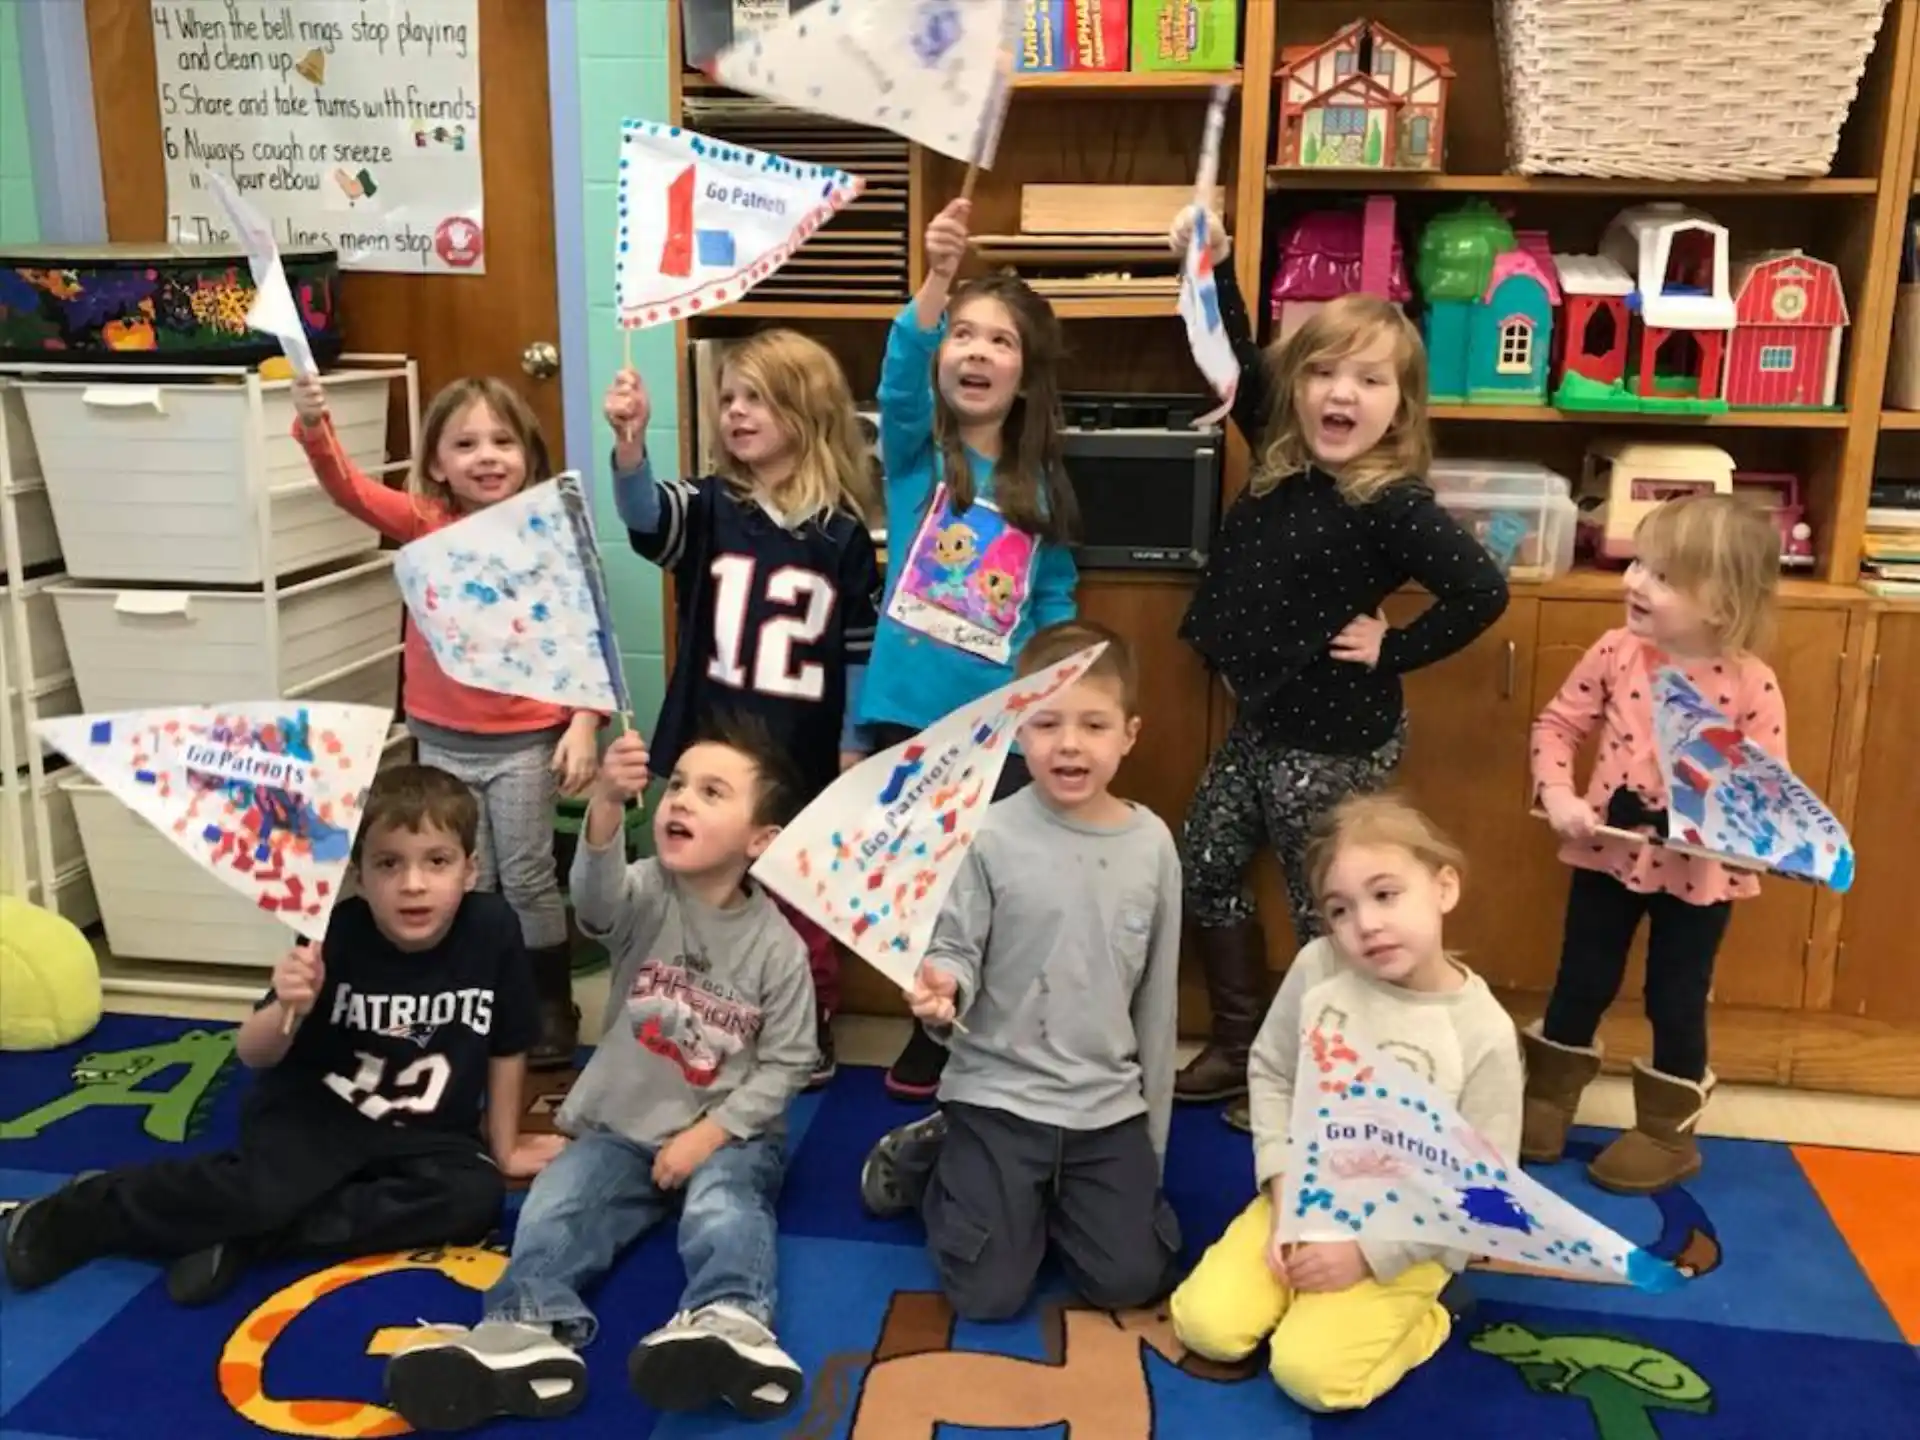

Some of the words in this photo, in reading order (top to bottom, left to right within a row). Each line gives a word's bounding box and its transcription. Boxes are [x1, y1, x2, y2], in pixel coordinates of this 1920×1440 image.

[175, 7, 227, 41] When
[229, 7, 259, 41] the
[261, 7, 294, 41] bell
[299, 20, 343, 54] rings
[352, 10, 389, 55] stop
[397, 9, 468, 59] playing
[178, 41, 210, 71] and
[214, 43, 263, 71] clean
[268, 52, 293, 84] up
[179, 81, 234, 116] Share
[238, 88, 269, 117] and
[274, 84, 310, 117] take
[315, 87, 361, 118] turns
[363, 87, 405, 119] with
[406, 83, 476, 119] friends
[184, 127, 245, 172] Always
[252, 130, 304, 170] cough
[309, 144, 327, 162] or
[333, 143, 393, 164] sneeze
[232, 172, 265, 196] your
[269, 164, 320, 190] elbow
[705, 180, 728, 203] Go
[731, 186, 786, 216] Patriots
[191, 215, 230, 245] The
[286, 216, 333, 247] lines
[340, 231, 390, 252] mean
[394, 222, 433, 267] stop
[706, 551, 837, 702] 12
[186, 744, 215, 766] Go
[218, 750, 305, 785] Patriots
[861, 831, 889, 858] Go
[885, 746, 960, 829] Patriots
[329, 981, 495, 1037] PATRIOTS
[1325, 1122, 1357, 1140] Go
[1363, 1122, 1461, 1173] Patriots
